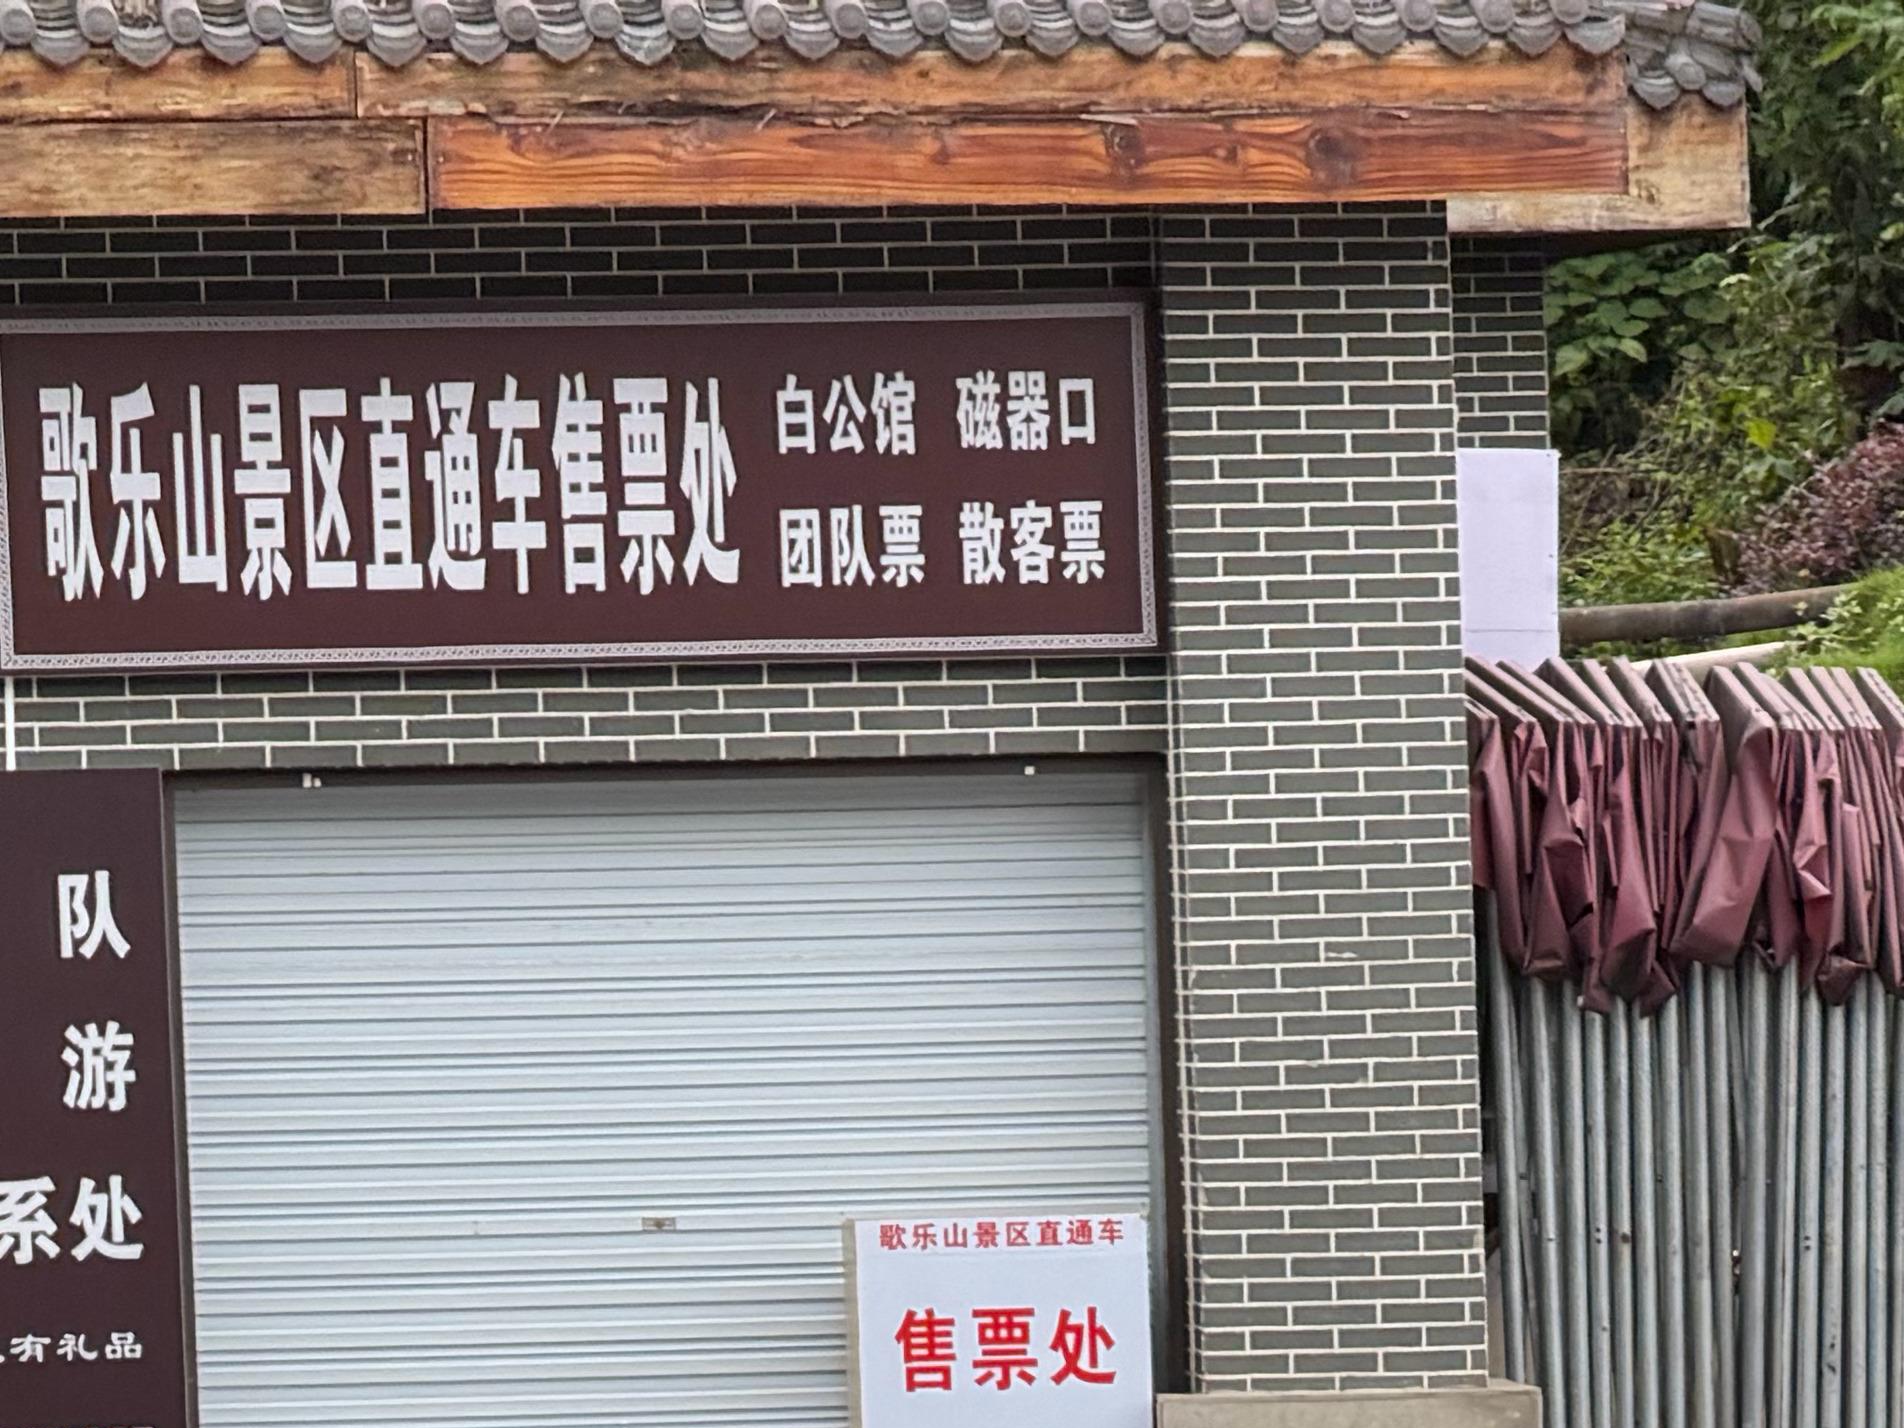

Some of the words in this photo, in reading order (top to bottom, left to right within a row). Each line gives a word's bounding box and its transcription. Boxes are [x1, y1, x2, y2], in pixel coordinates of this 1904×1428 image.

[40, 373, 740, 602] 歌乐山景区直通车售票处
[776, 371, 916, 456] 白公馆
[955, 370, 1096, 451] 磁器口
[779, 504, 926, 588] 团队票
[958, 499, 1106, 585] 散客票
[57, 870, 131, 959] 队
[61, 1020, 136, 1112] 游
[879, 1219, 1124, 1250] 歌乐山景区直通车
[0, 1331, 142, 1363] 有礼品
[894, 1306, 1117, 1393] 售票处
